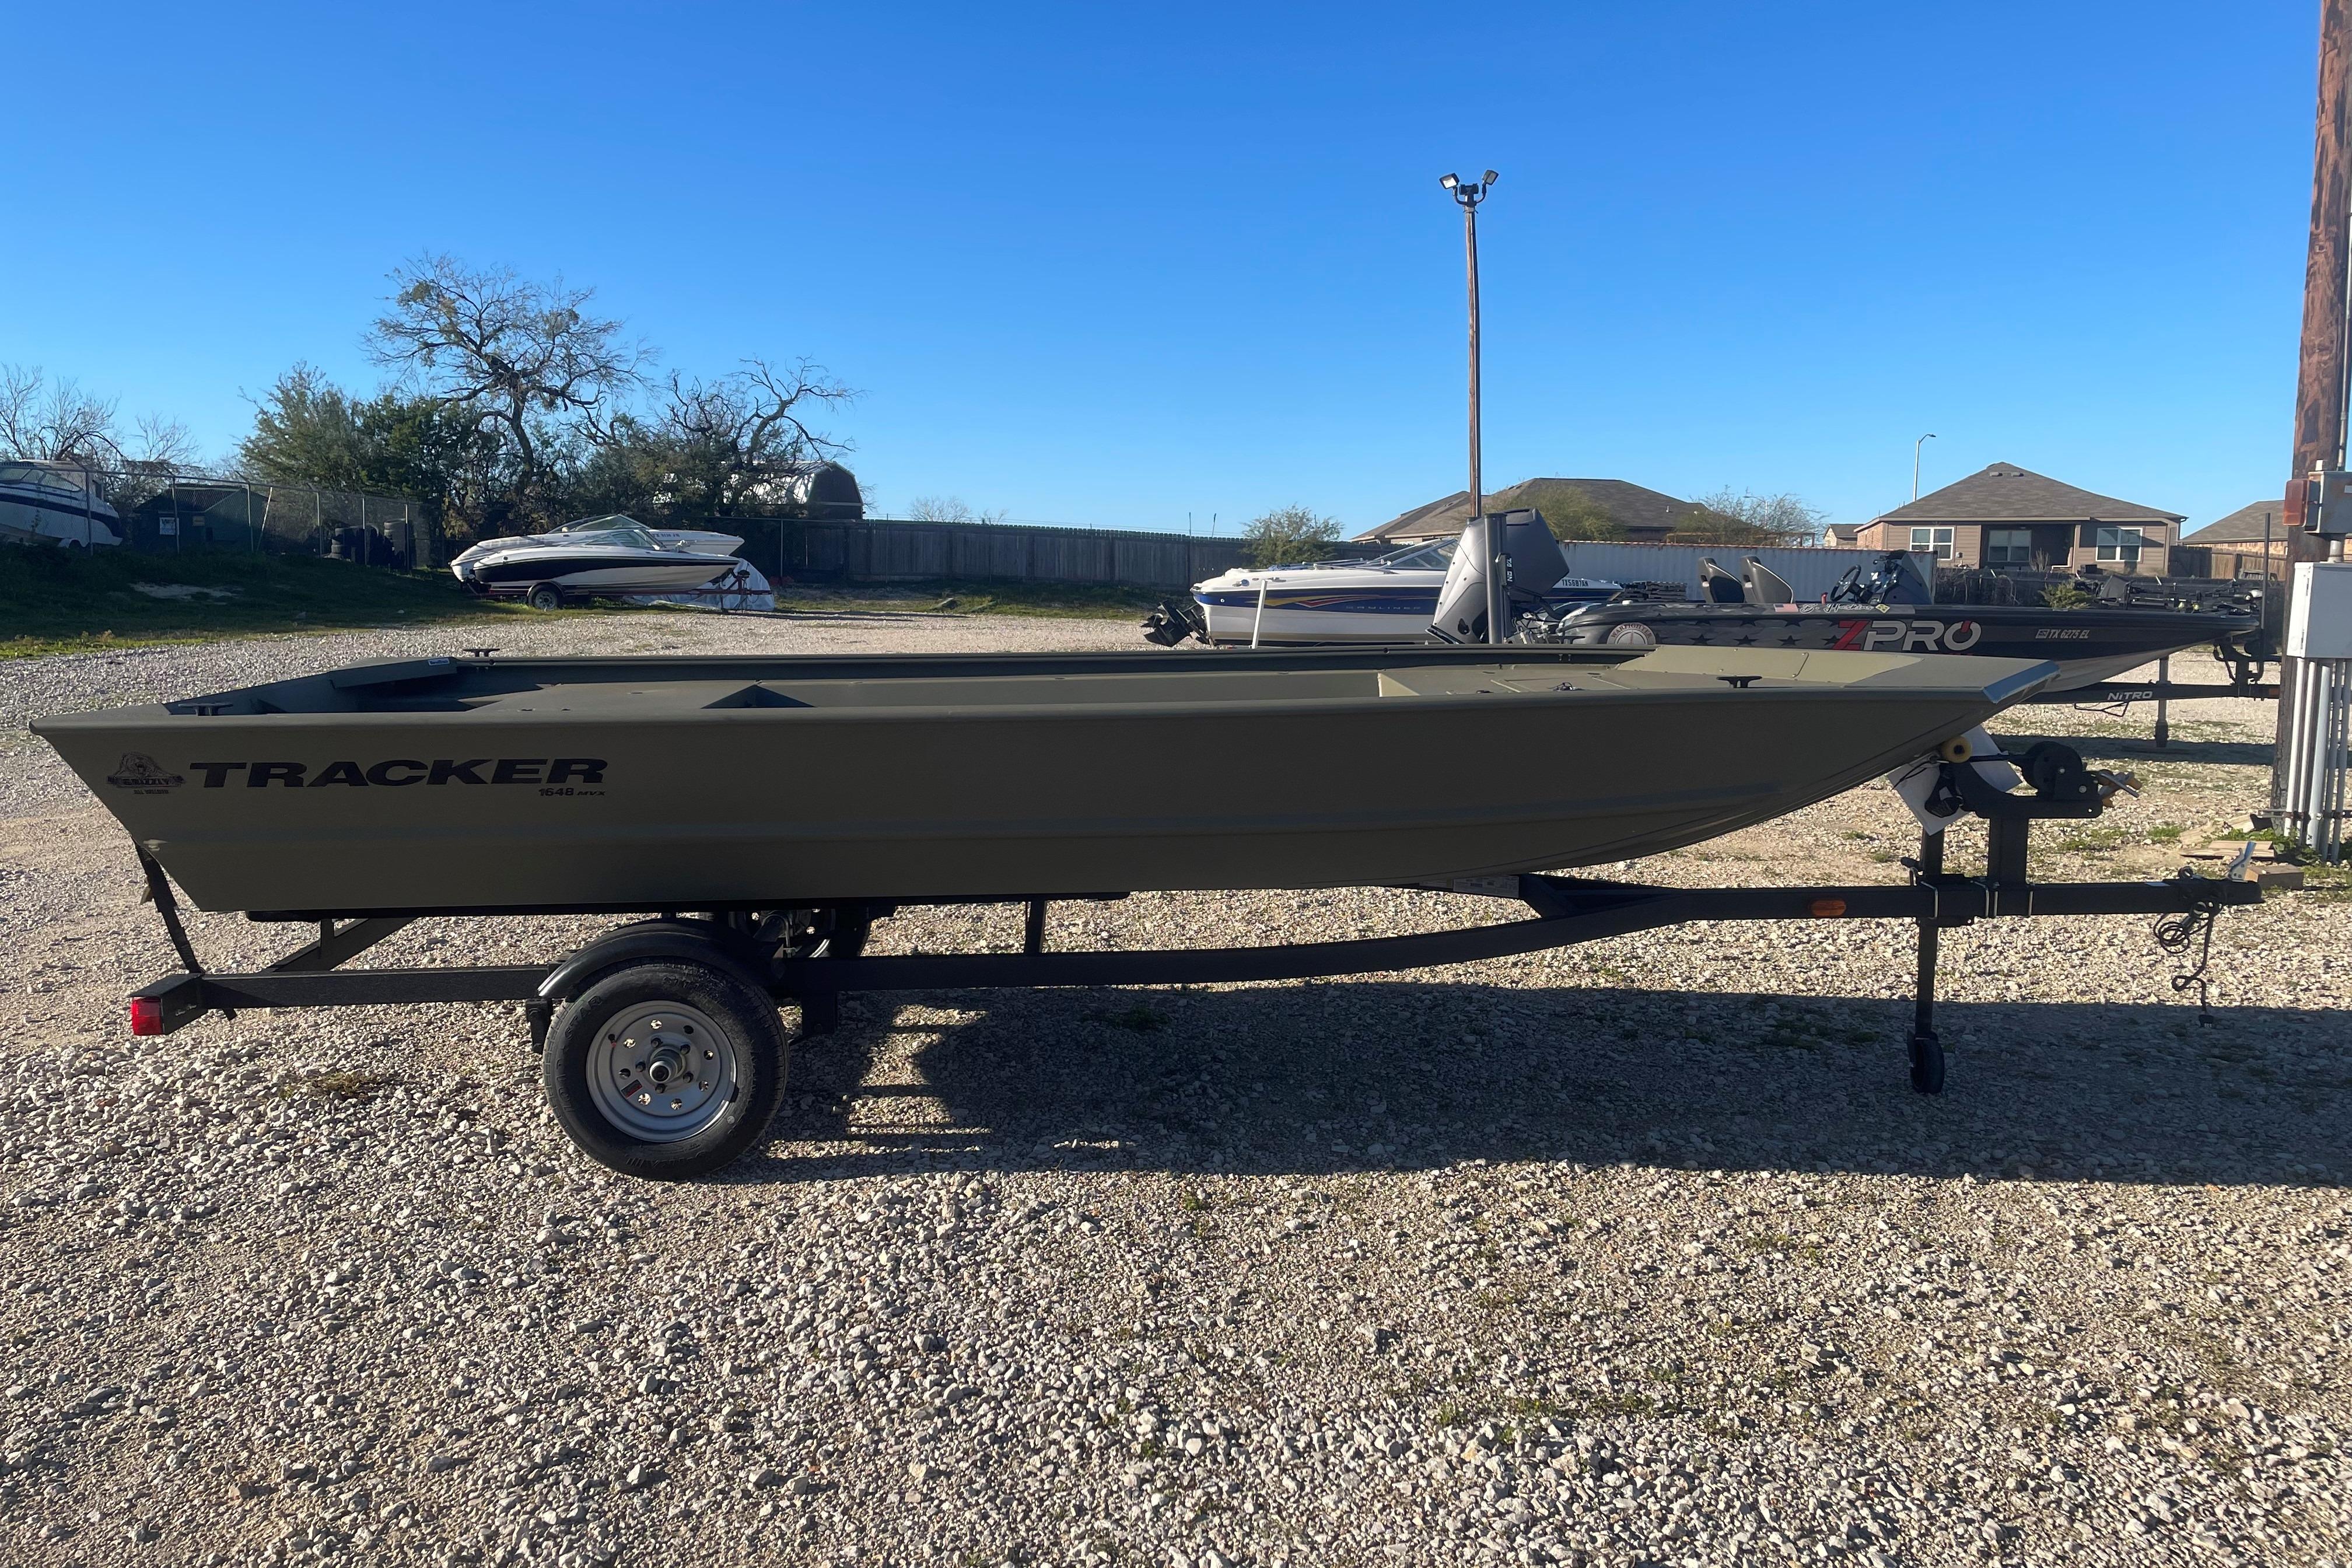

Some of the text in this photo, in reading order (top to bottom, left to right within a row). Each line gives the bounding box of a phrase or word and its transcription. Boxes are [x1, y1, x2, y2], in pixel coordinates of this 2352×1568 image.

[1611, 623, 1652, 639] WARFIGHTER
[2049, 629, 2090, 639] TX 6275 EL
[190, 759, 609, 788] TRACKER
[538, 788, 574, 796] 1648
